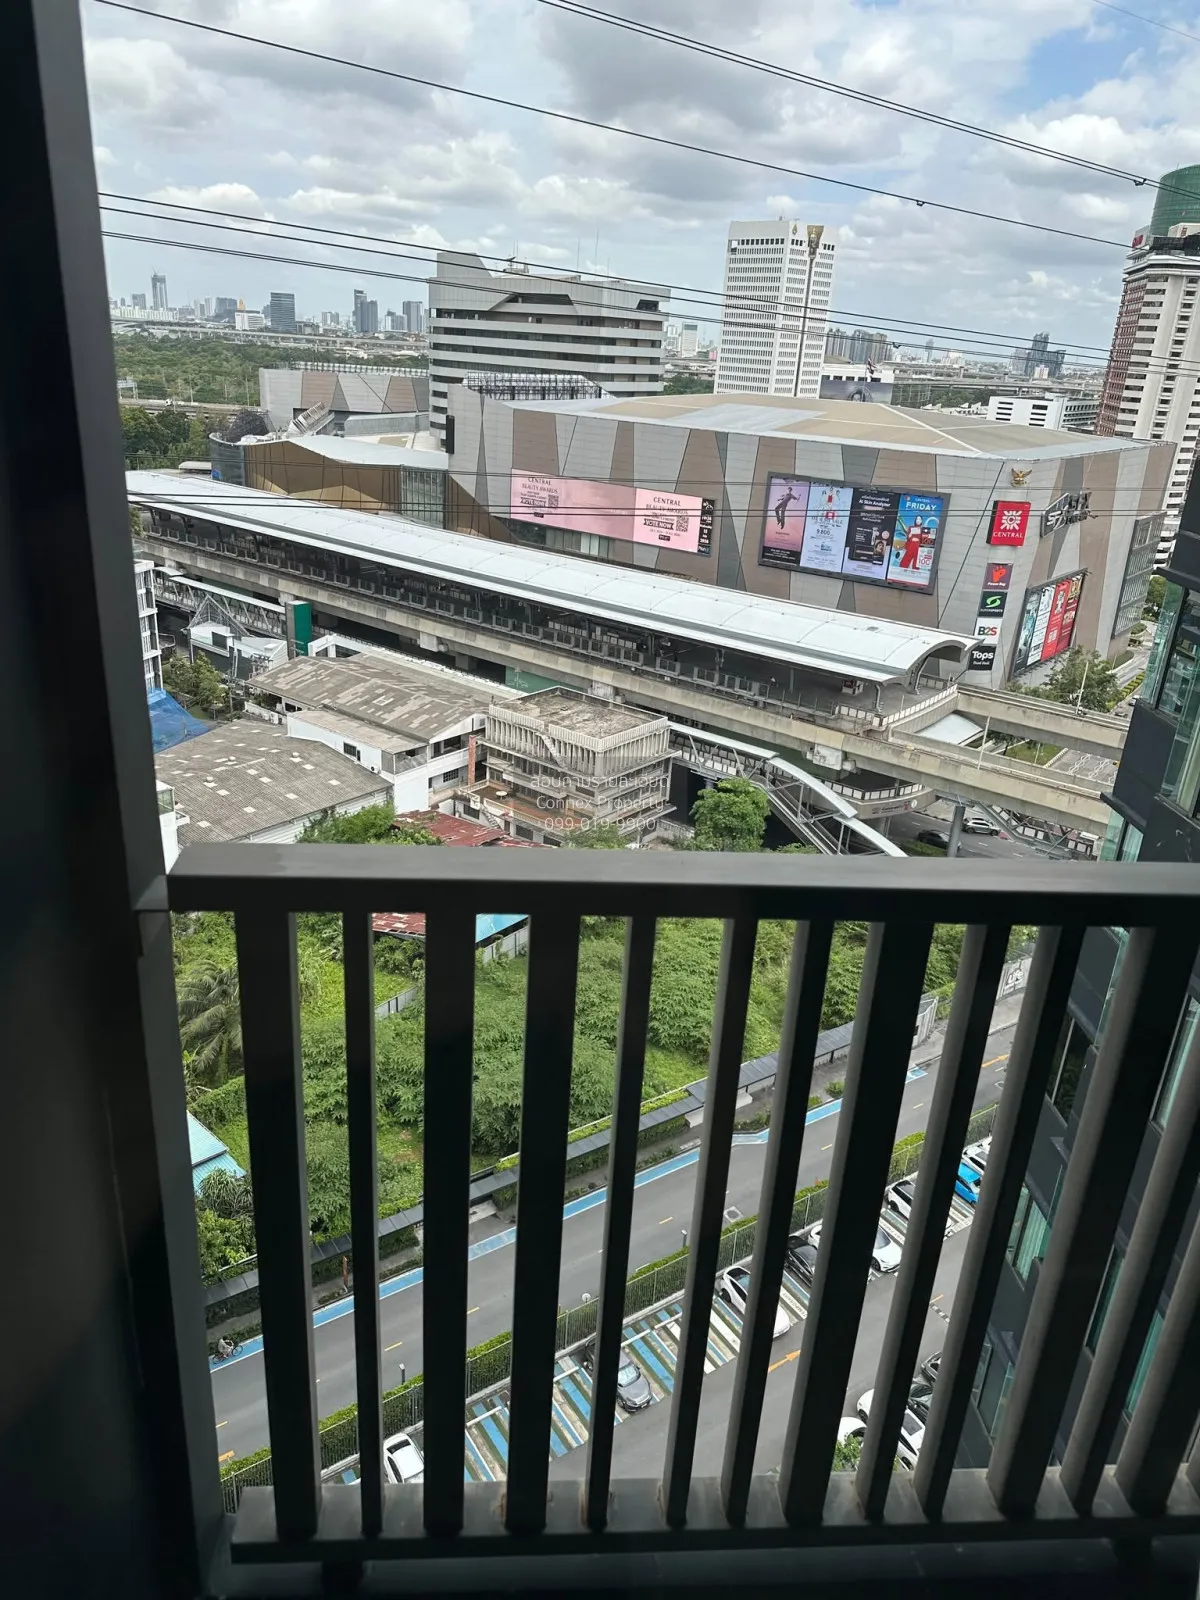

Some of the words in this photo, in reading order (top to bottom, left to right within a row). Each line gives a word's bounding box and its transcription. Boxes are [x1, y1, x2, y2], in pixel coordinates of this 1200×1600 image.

[527, 477, 552, 486] CENTRAL
[653, 496, 681, 507] CENTRAL
[906, 501, 937, 511] FRIDAY
[645, 519, 659, 527] VOTE
[659, 521, 672, 529] NOW
[977, 626, 998, 636] B2S
[972, 650, 994, 661] Tops
